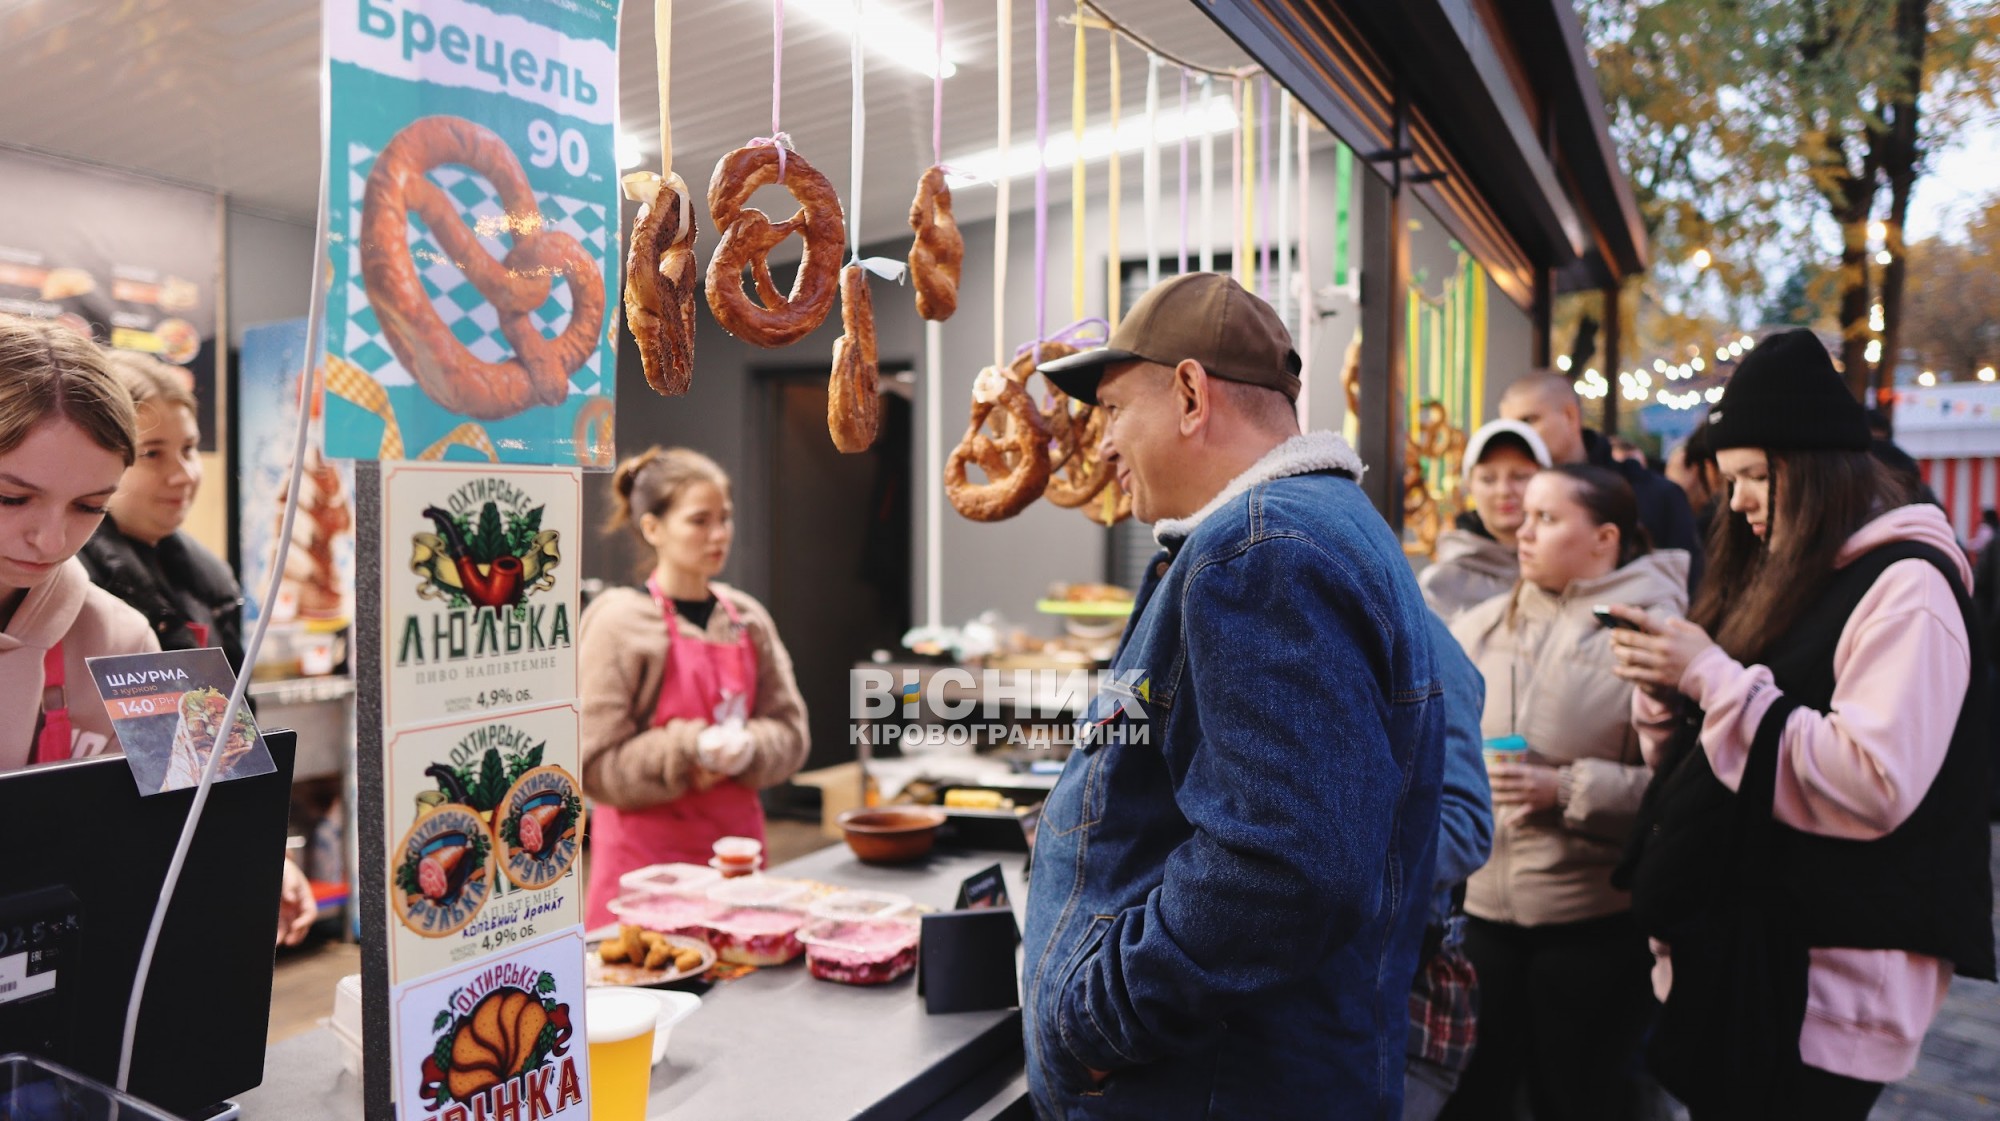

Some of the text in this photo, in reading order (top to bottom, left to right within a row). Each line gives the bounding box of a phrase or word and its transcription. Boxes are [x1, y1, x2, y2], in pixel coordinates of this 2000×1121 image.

[357, 0, 598, 105] Брецель
[528, 118, 589, 177] 90
[448, 478, 532, 516] ОХТИРСЬКЕ
[397, 603, 571, 667] ЛЮЛЬКА
[106, 668, 189, 687] ШАУРМА
[121, 685, 158, 696] куркою
[416, 656, 557, 685] ПИВО НАПІВТЕМНЕ
[118, 696, 176, 716] 140 ГРН
[477, 688, 513, 709] 4,9%
[450, 724, 532, 768] ОХТИРСЬКЕ
[509, 839, 576, 885] РУЛЬКА
[407, 881, 486, 932] РУЛЬКА
[482, 929, 517, 951] 4,9%
[457, 963, 538, 1013] ОХТИРСЬКЕ
